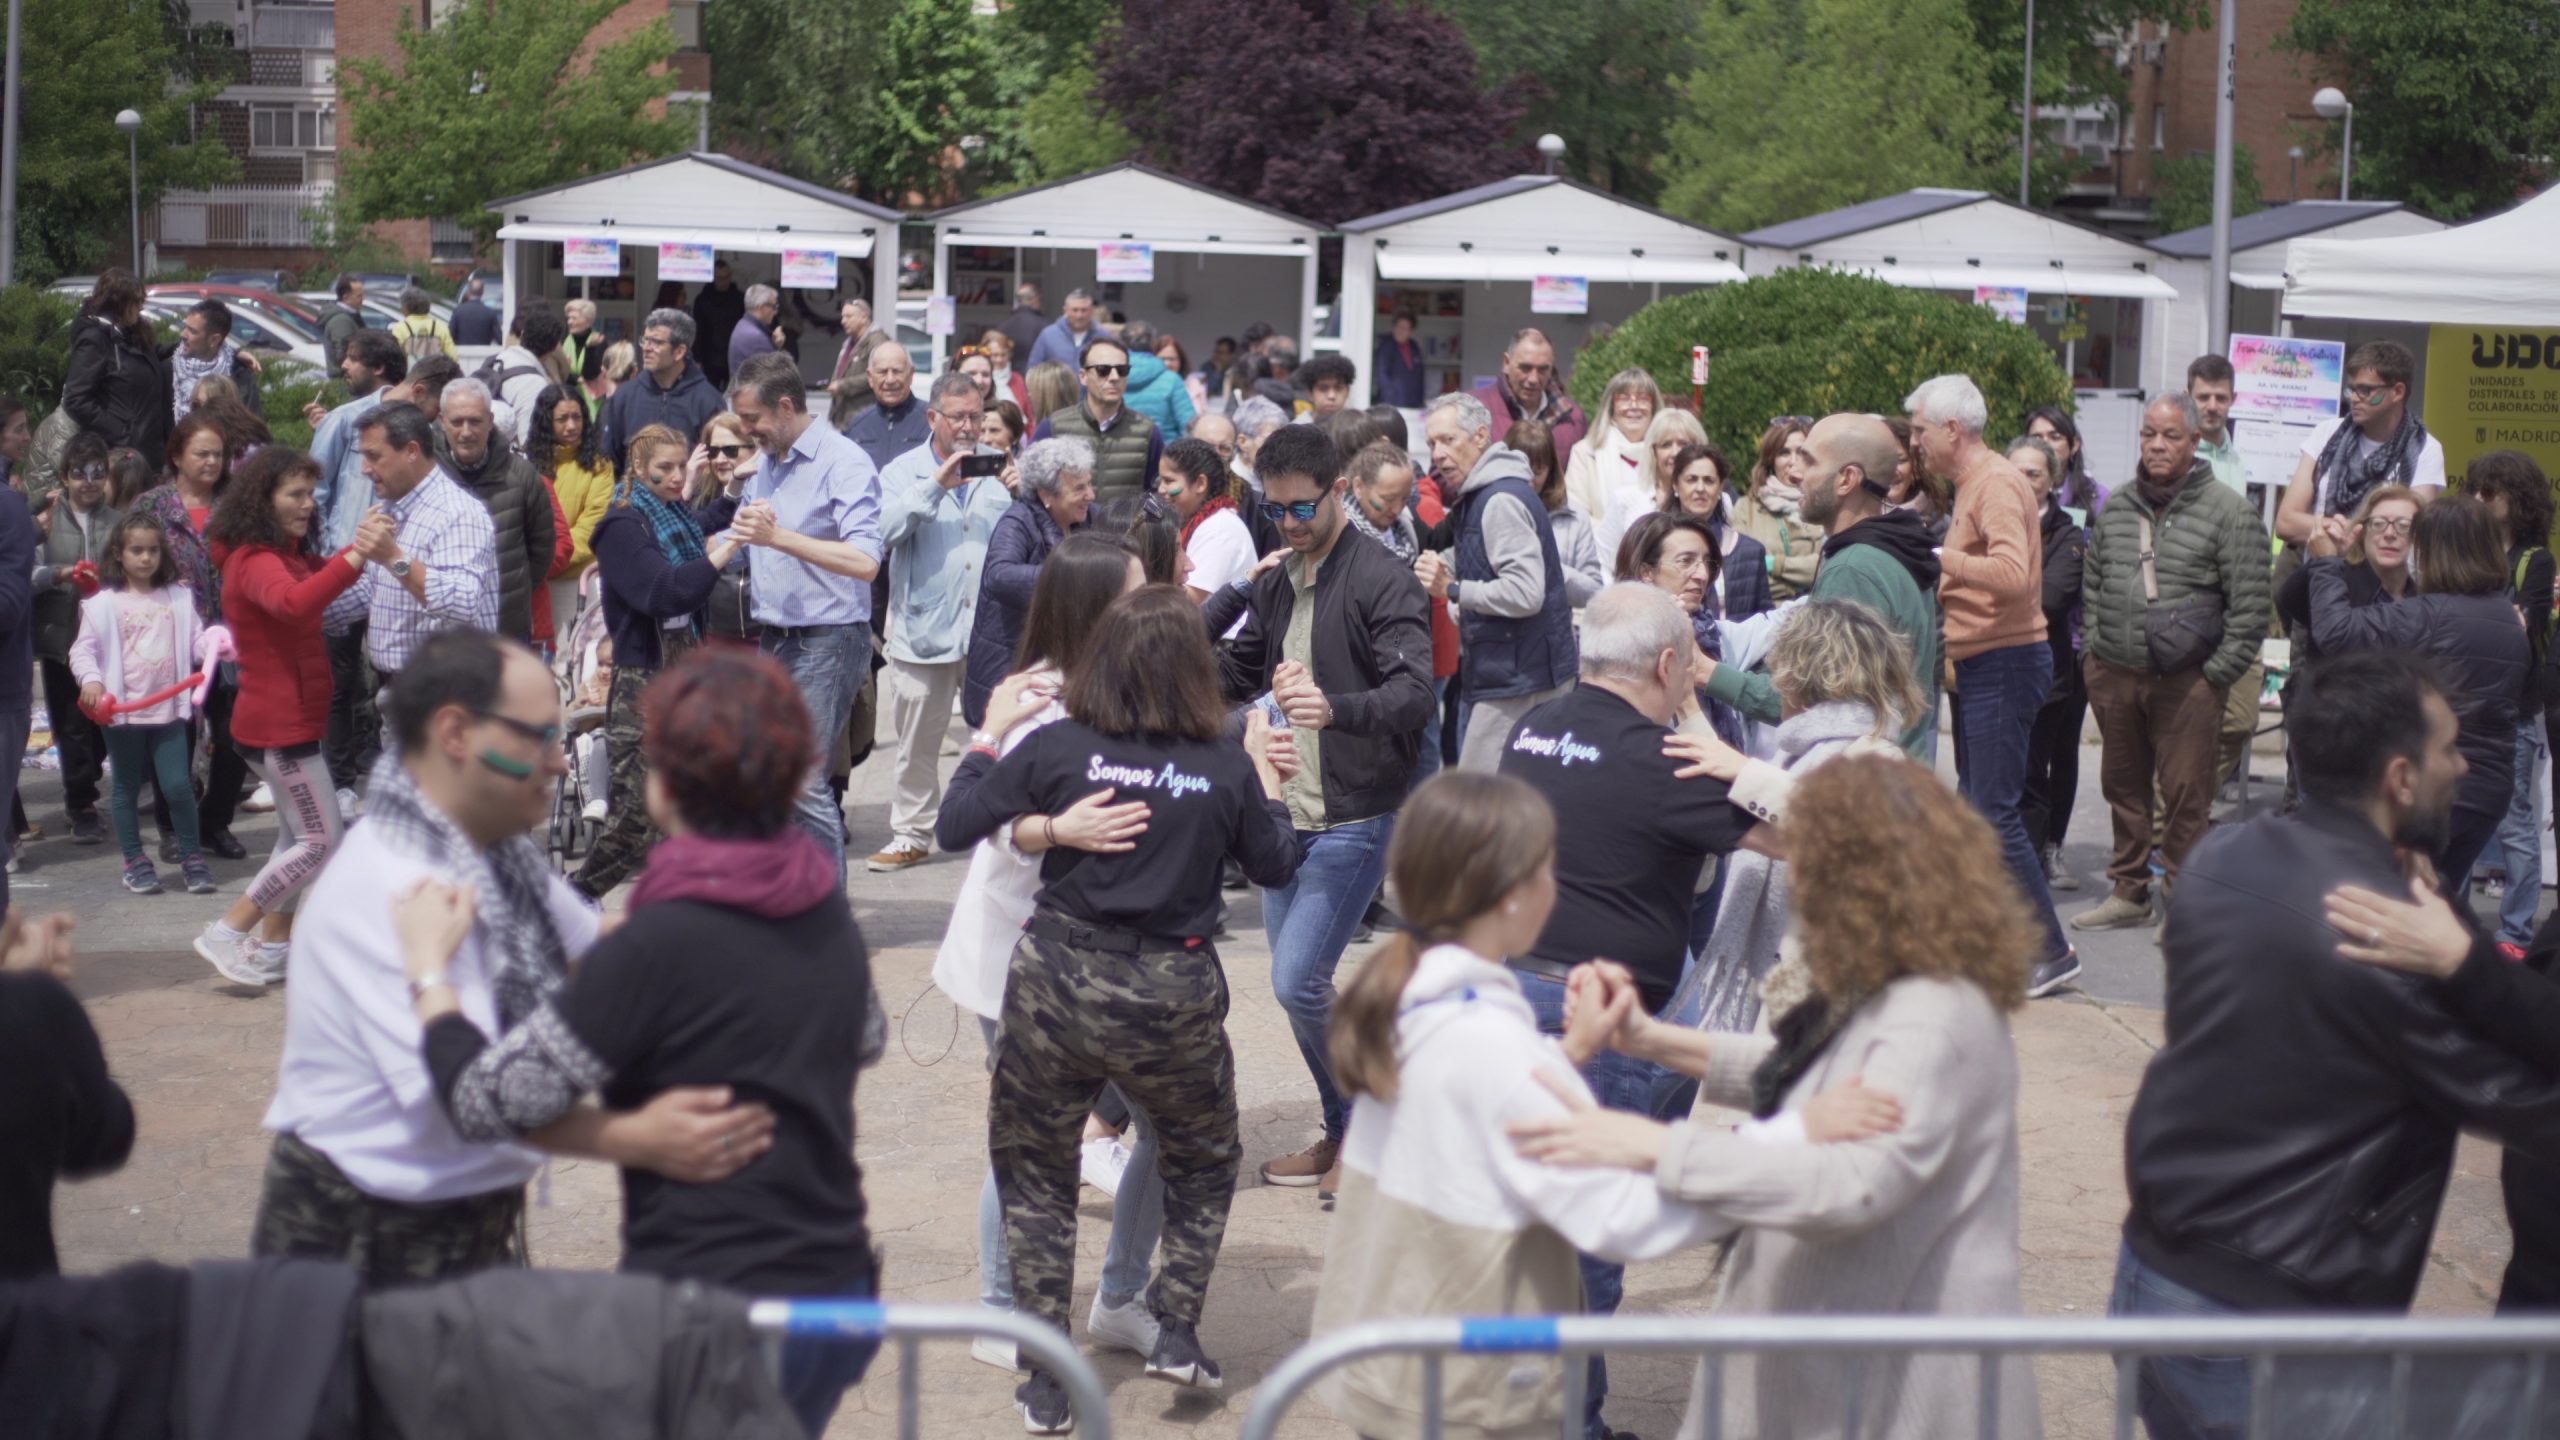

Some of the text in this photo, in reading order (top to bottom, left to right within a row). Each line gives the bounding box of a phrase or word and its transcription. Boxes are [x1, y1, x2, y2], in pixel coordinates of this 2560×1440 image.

[2469, 376, 2525, 387] UNIDADES
[2468, 388, 2558, 401] DISTRITALES DE
[2467, 401, 2559, 414] COLABORACIÓN
[2496, 430, 2560, 443] MADRID
[1512, 727, 1601, 766] Somos Agua
[1087, 755, 1212, 798] Somos Agua
[289, 783, 327, 835] GYMNAST
